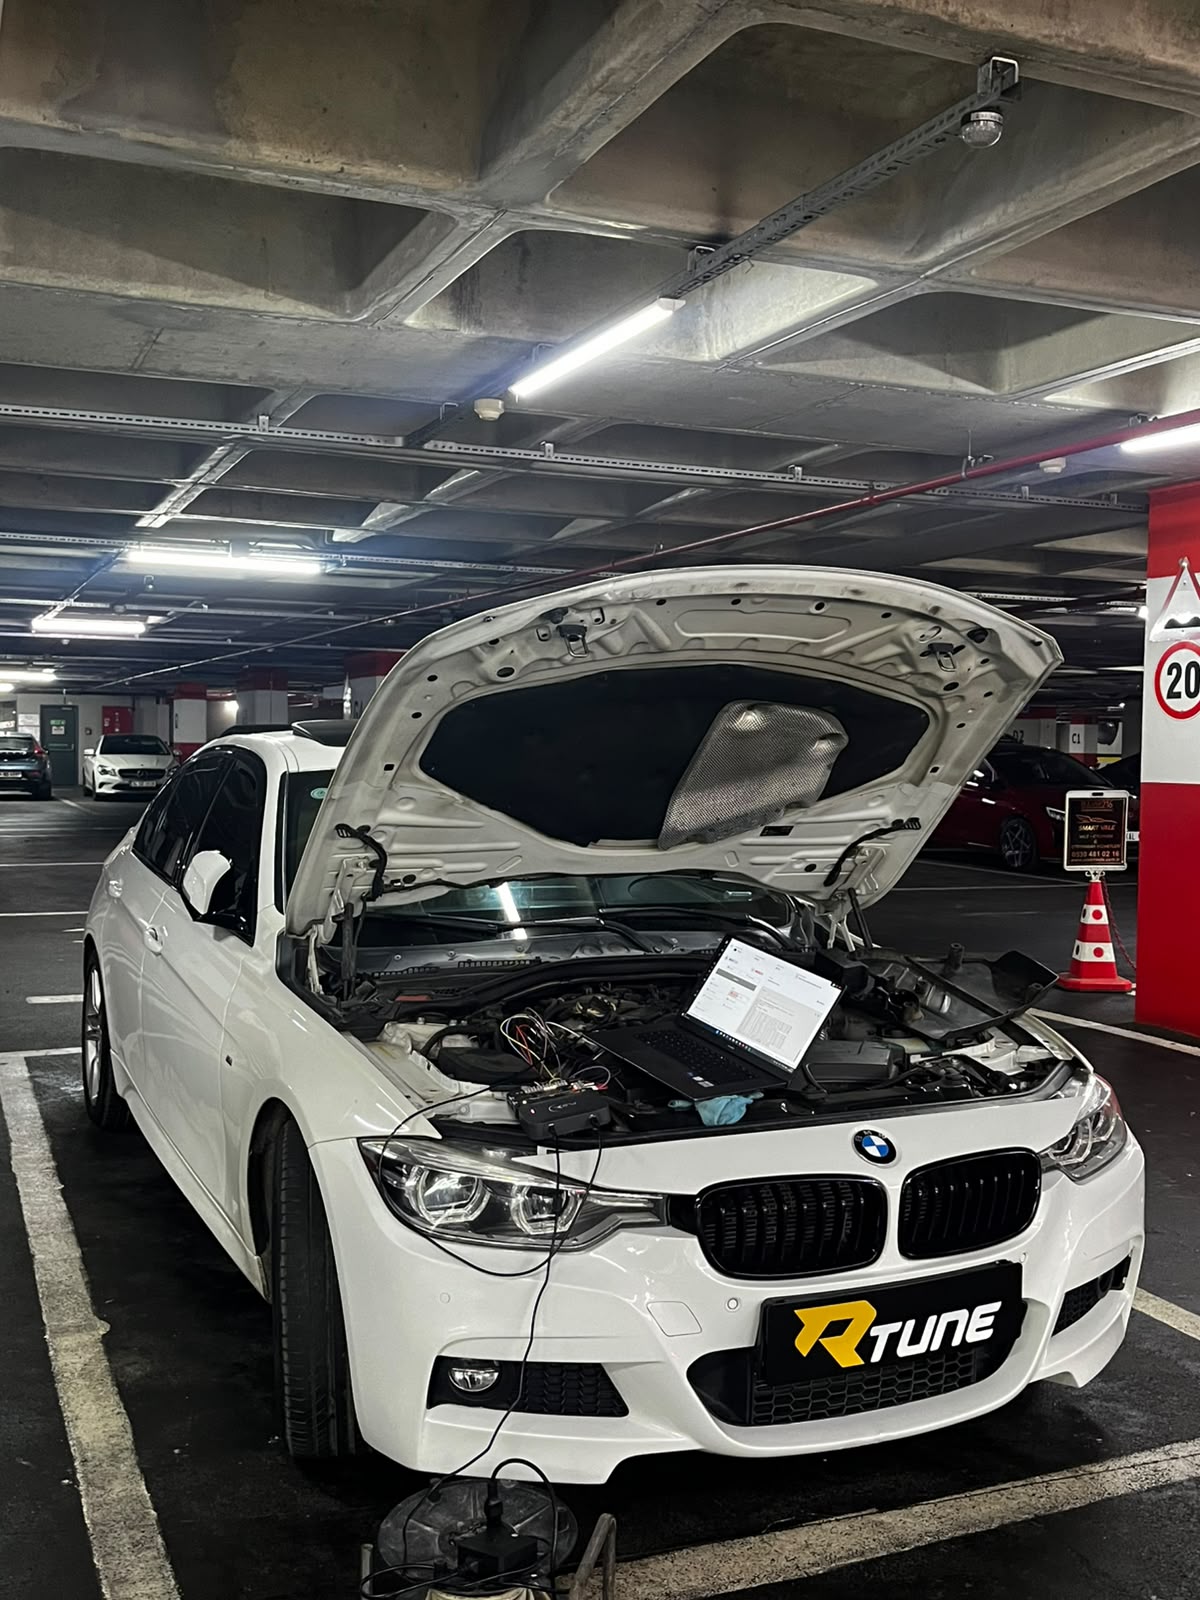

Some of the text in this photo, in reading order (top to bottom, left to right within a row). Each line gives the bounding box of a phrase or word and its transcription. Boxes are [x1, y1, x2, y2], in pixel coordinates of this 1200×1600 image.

[1166, 660, 1200, 699] 20
[1071, 733, 1081, 744] C1
[1101, 850, 1110, 858] 02
